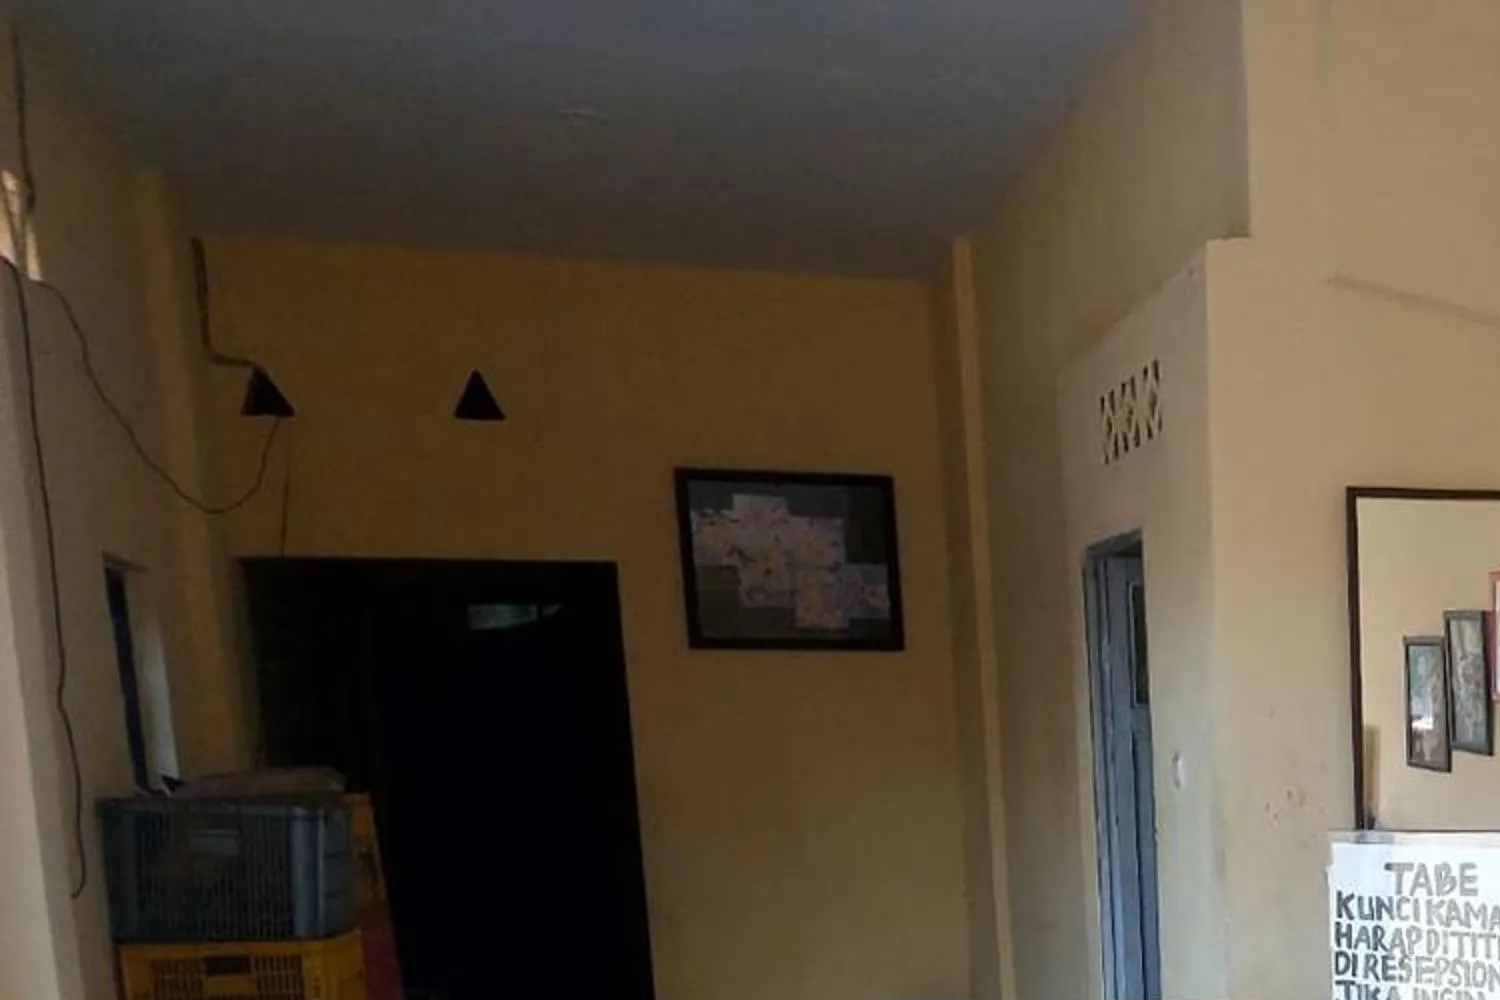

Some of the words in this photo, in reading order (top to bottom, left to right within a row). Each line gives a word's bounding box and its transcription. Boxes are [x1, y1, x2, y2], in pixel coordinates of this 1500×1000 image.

[1384, 862, 1478, 896] TABE
[1335, 890, 1420, 922] KUNCI
[1335, 922, 1422, 952] HARAP
[1335, 951, 1358, 977] DI
